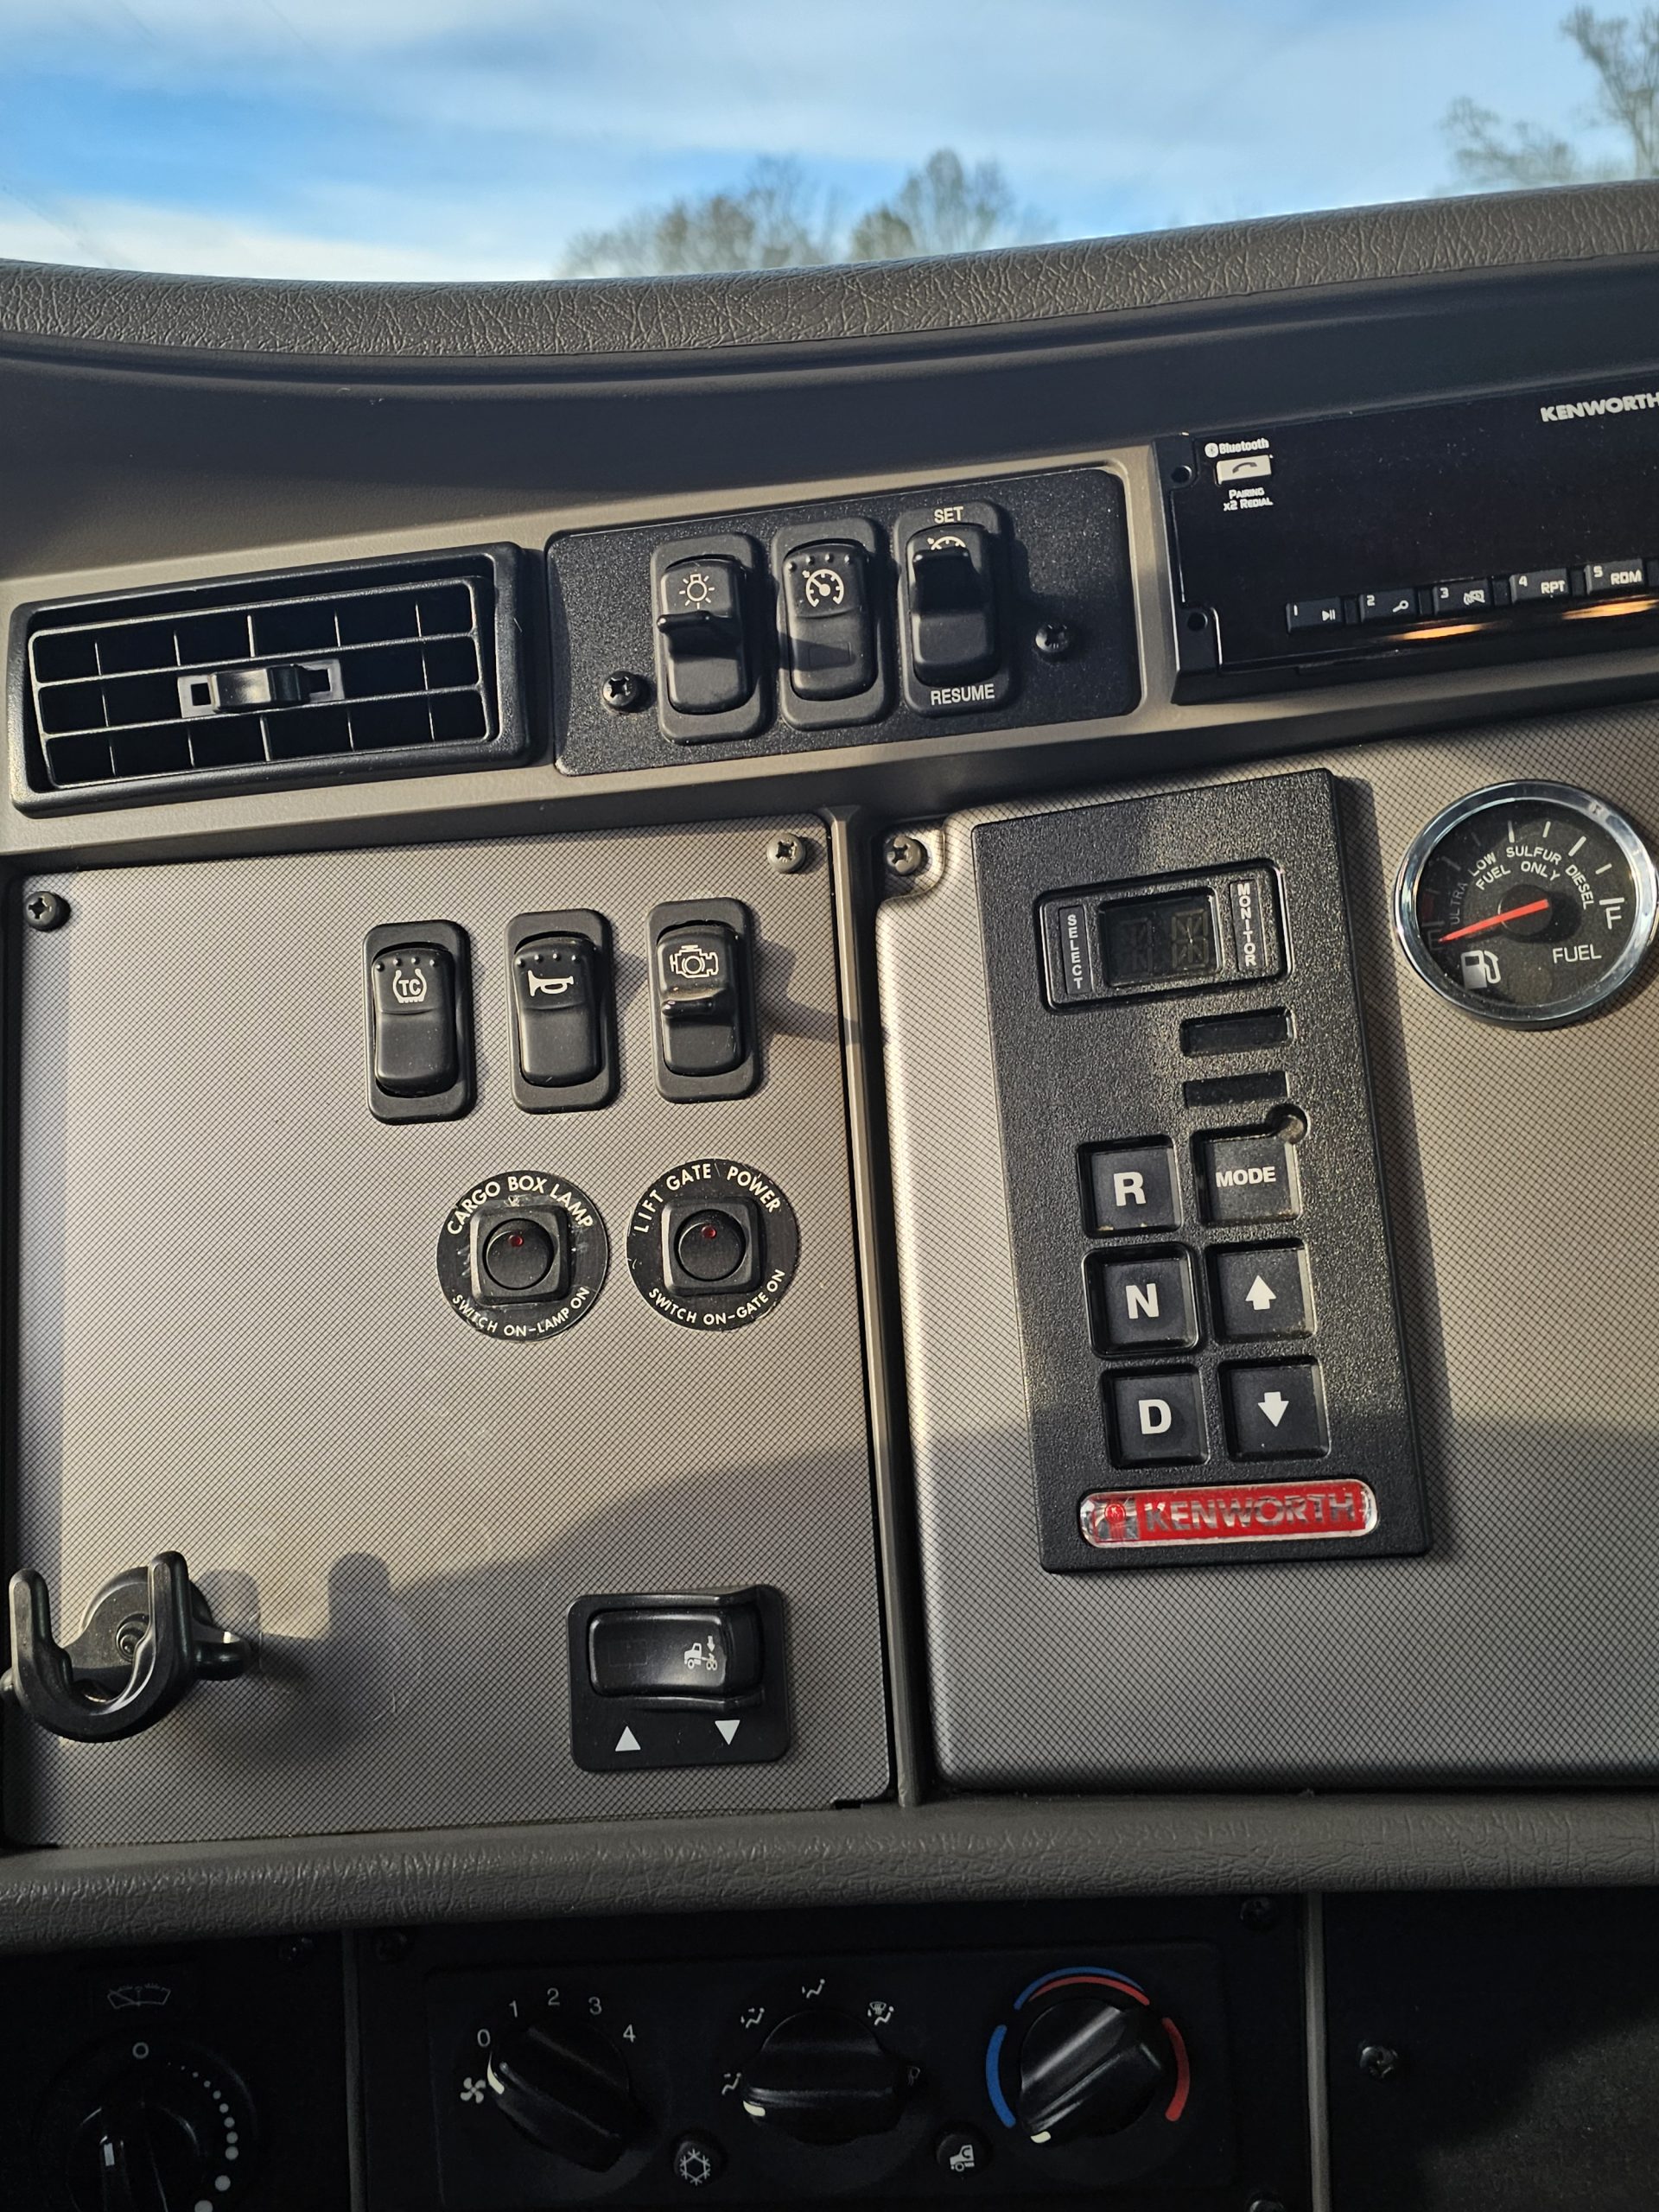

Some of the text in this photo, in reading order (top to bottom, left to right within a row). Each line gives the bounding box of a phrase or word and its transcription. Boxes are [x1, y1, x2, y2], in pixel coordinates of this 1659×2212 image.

[1540, 391, 1659, 422] KENWORTH
[1218, 437, 1269, 454] Bluetooth
[933, 506, 964, 524] SET
[1518, 575, 1528, 588] 4
[1593, 565, 1604, 578] 5
[1610, 569, 1642, 585] RDM
[1440, 587, 1450, 599] 3
[1541, 580, 1566, 594] RPT
[1366, 594, 1376, 607] 2
[930, 683, 995, 704] RESUME
[1449, 845, 1595, 925] ULTRA LOW SULFUR DIESEL
[1476, 861, 1560, 891] FUEL ONLY
[1236, 882, 1256, 967] MONITOR
[1605, 906, 1623, 930] F
[1066, 913, 1083, 990] SELECT
[1552, 944, 1602, 963] FUEL
[398, 978, 423, 996] TC
[1216, 1166, 1277, 1188] MODE
[633, 1163, 781, 1233] LIFT GATE POWER
[1113, 1172, 1147, 1206] R
[447, 1175, 594, 1236] CARGO BOX LAMP
[648, 1287, 697, 1324] SWITCH
[766, 1268, 785, 1293] ON
[1126, 1283, 1159, 1319] N
[452, 1294, 499, 1333] SWITCH
[570, 1287, 590, 1309] ON
[1138, 1399, 1173, 1435] D
[1143, 1492, 1357, 1533] KENWORTH
[546, 1986, 561, 2006] 2
[588, 1996, 602, 2016] 3
[507, 1999, 518, 2018] 1
[476, 2027, 492, 2048] 0
[622, 2023, 637, 2044] 4
